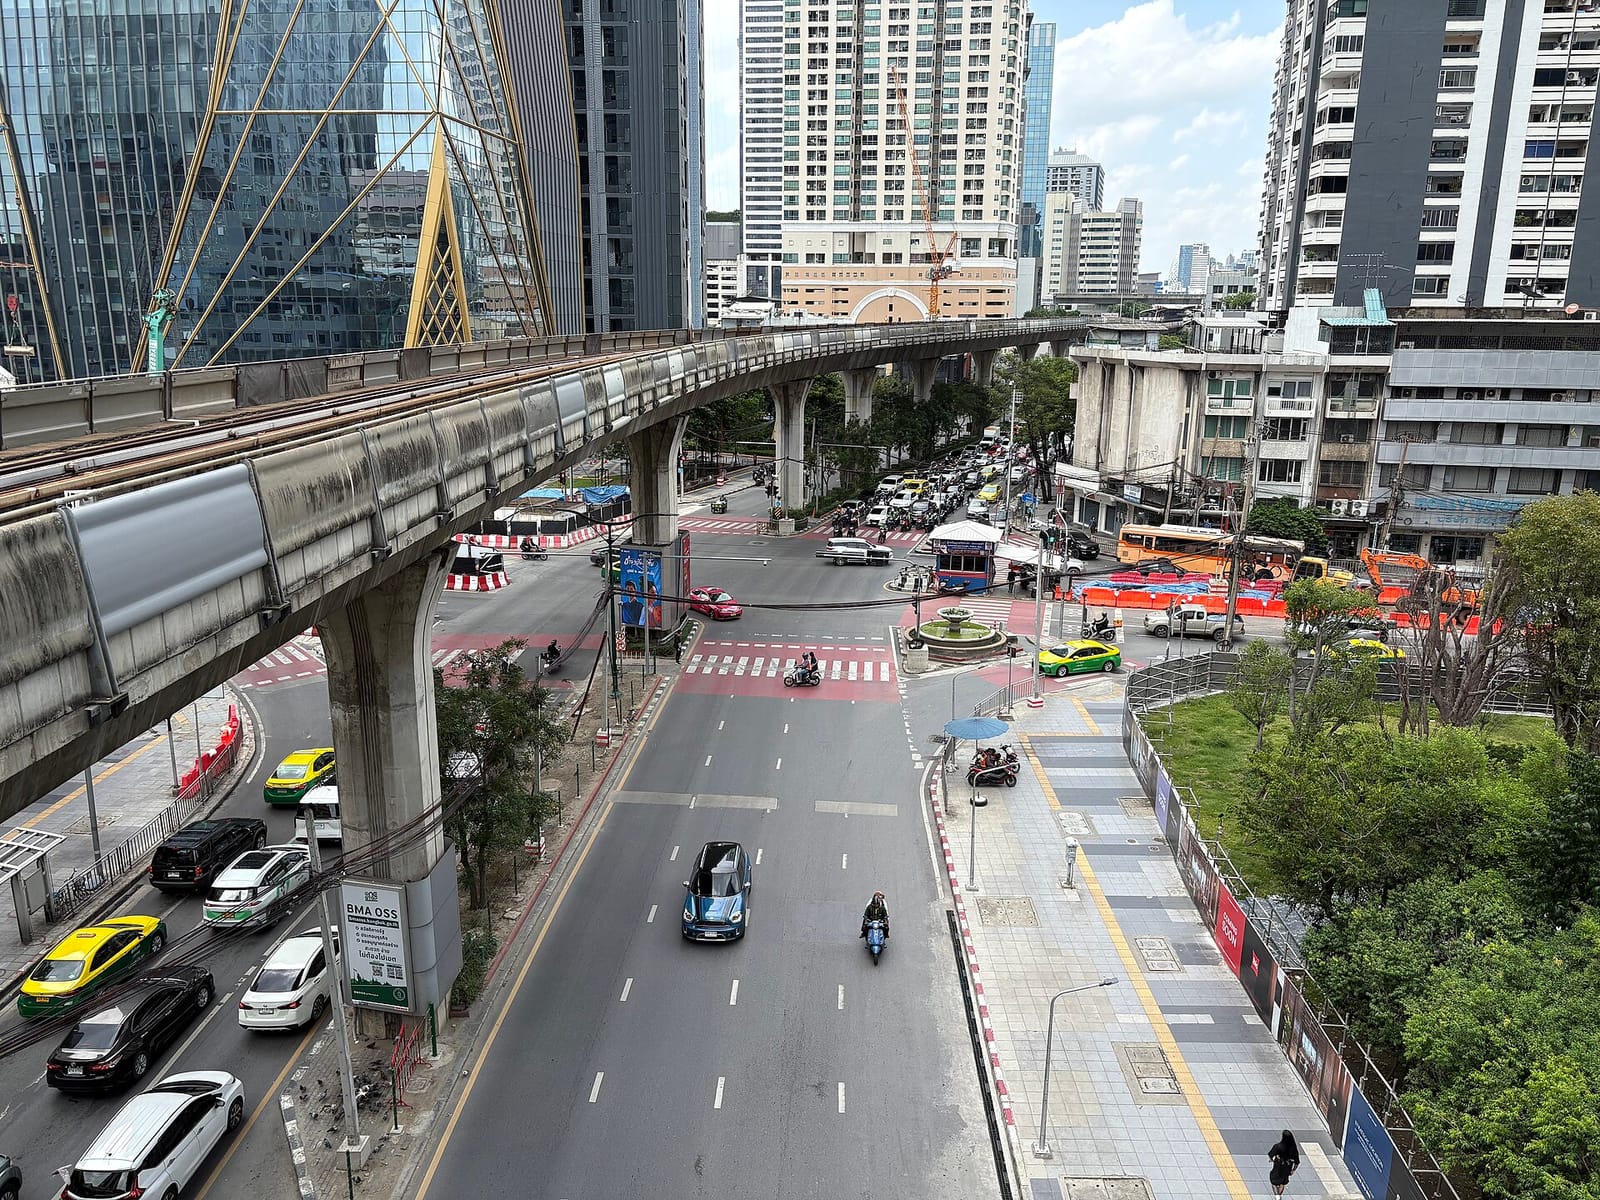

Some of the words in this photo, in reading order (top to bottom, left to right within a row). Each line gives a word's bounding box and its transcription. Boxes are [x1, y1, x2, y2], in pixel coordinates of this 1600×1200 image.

[346, 903, 372, 917] BMA
[374, 907, 398, 919] OSS
[1222, 920, 1237, 948] SOON
[1223, 912, 1238, 936] COMING
